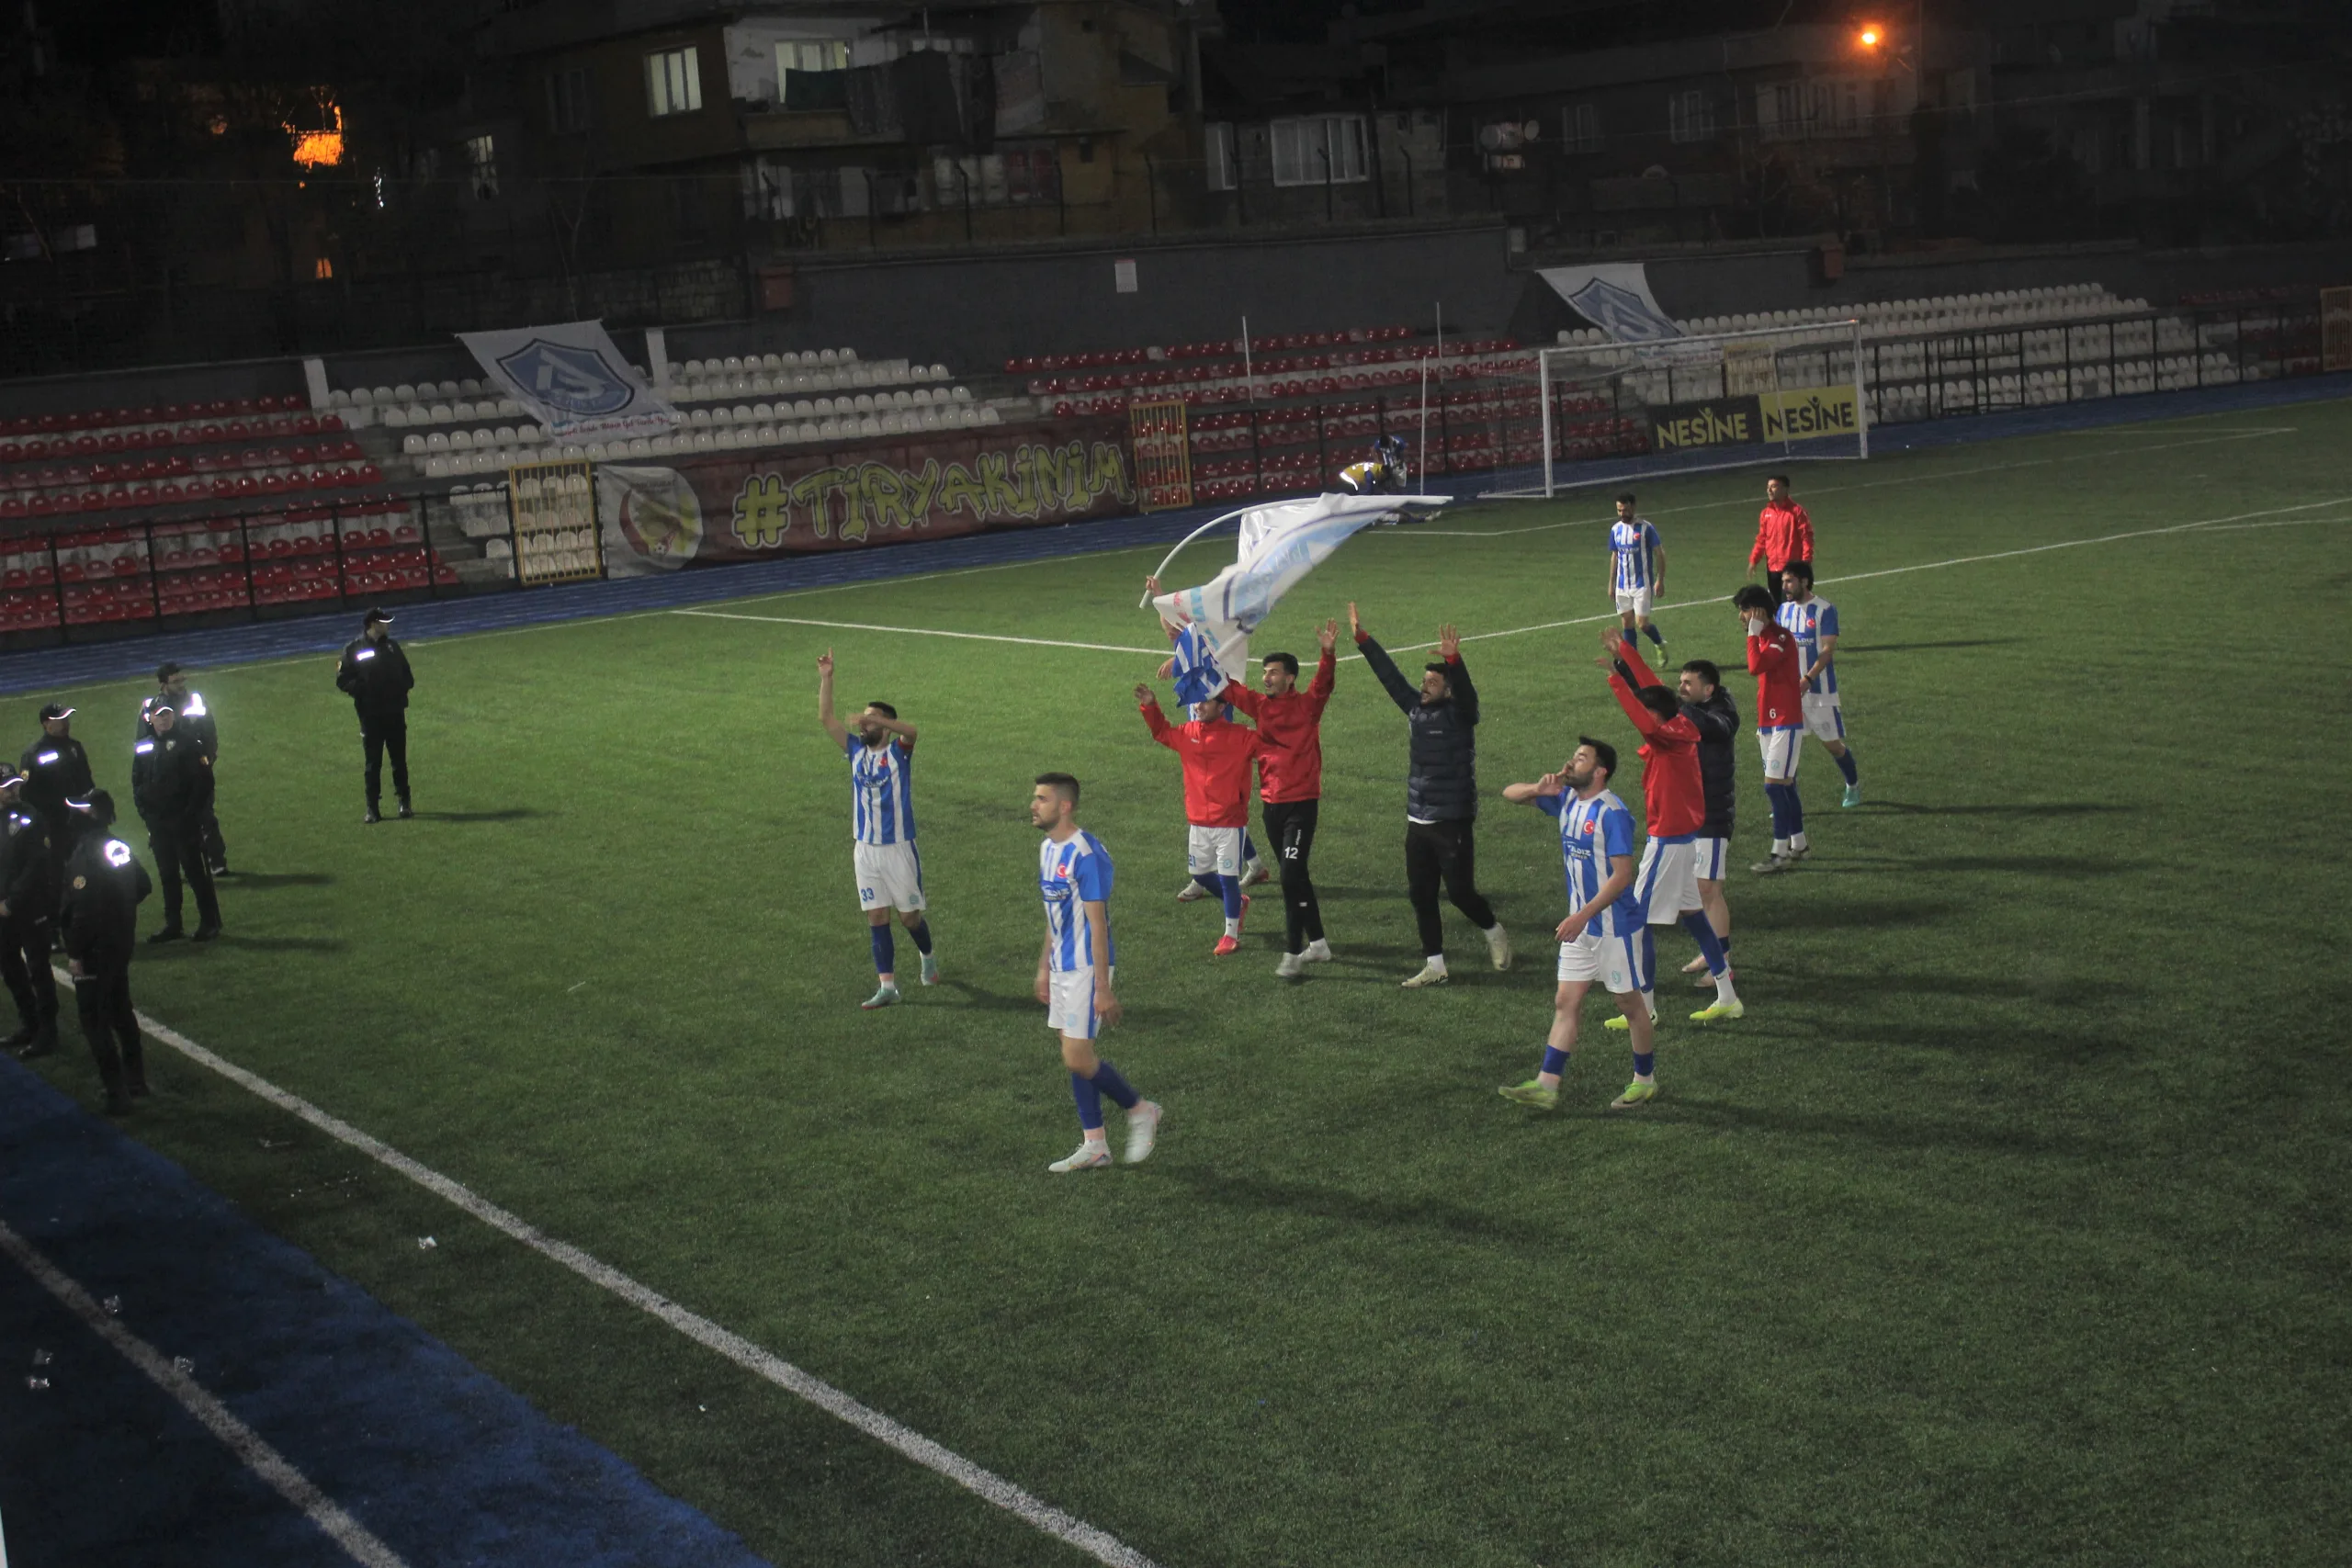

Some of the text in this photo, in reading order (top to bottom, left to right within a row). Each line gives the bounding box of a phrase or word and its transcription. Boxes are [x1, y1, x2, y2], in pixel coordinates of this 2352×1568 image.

[1769, 707, 1777, 719] 6
[1284, 846, 1299, 860] 12
[860, 887, 875, 902] 33
